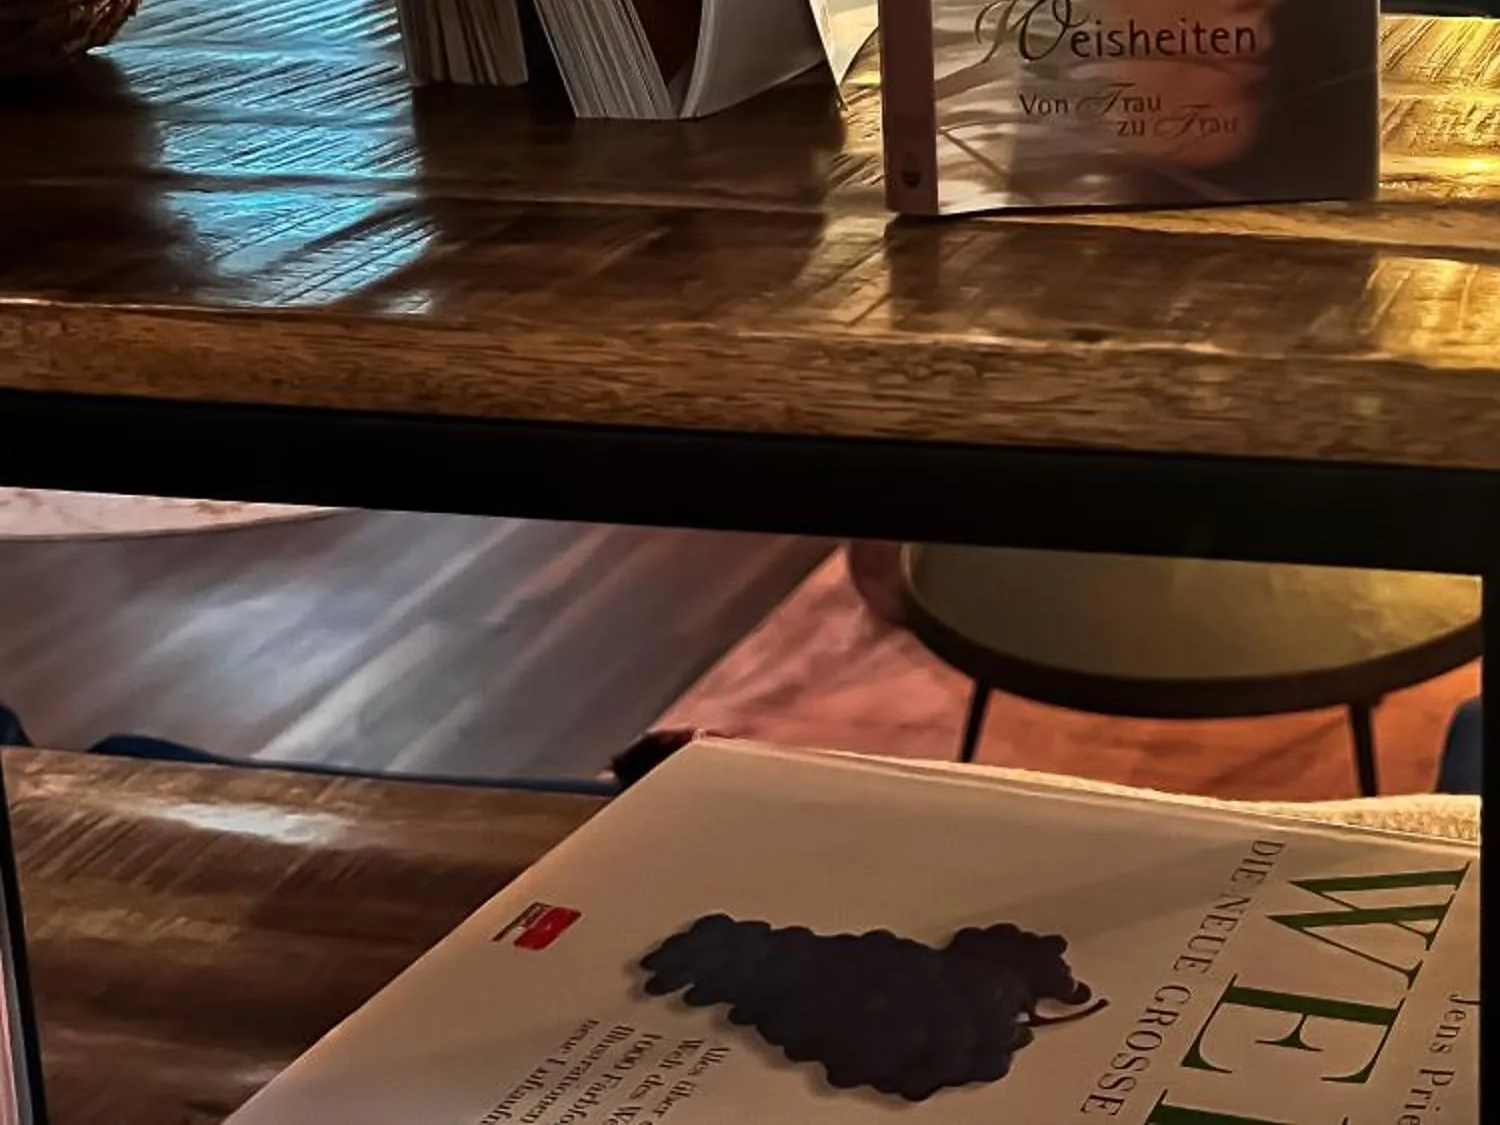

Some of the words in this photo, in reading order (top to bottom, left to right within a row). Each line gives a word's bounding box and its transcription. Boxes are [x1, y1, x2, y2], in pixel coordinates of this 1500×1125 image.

[1018, 93, 1070, 117] Von
[1076, 82, 1162, 117] Frau
[1116, 120, 1147, 137] zu
[1154, 104, 1239, 137] Frau
[1231, 839, 1286, 884] DIE
[1173, 893, 1251, 975] NEUE
[1429, 993, 1481, 1053] Jens
[658, 1037, 705, 1070] Welt
[687, 1046, 731, 1076] Alles
[1080, 984, 1192, 1116] GROSSE
[554, 1073, 624, 1125] Farbfo
[629, 1074, 665, 1100] des
[652, 1079, 697, 1118] über
[1398, 1068, 1455, 1125] Prie
